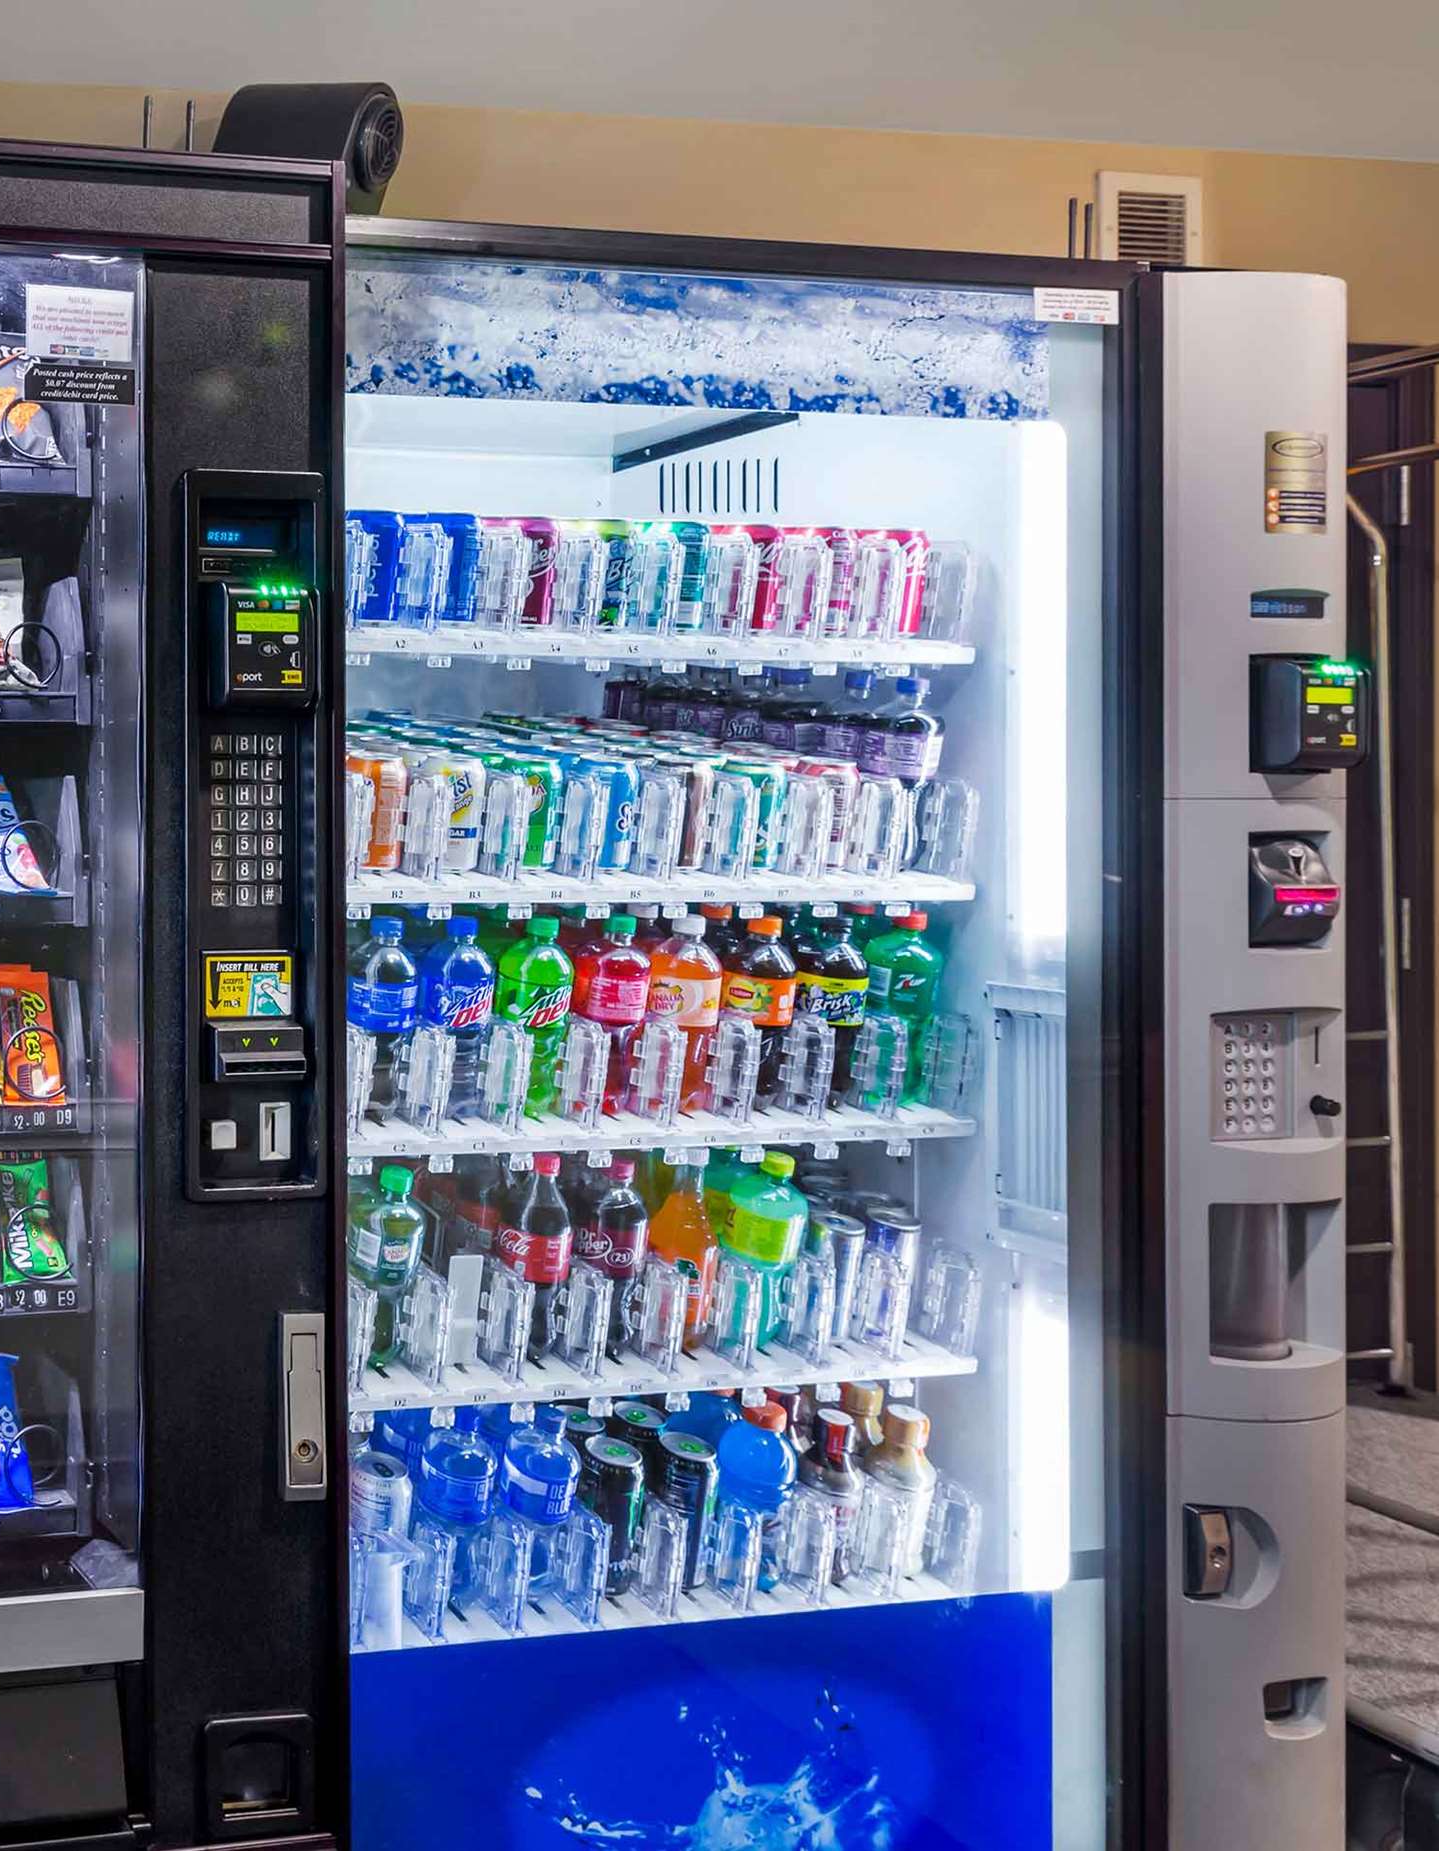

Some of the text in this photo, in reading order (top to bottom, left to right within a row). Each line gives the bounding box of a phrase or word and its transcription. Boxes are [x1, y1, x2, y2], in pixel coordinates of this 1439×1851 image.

[33, 368, 57, 377] Posted
[58, 369, 74, 378] cash
[75, 371, 94, 380] price
[95, 370, 121, 381] reflects
[66, 380, 115, 391] discount from
[82, 391, 98, 400] card
[237, 600, 255, 609] VISA
[214, 737, 274, 750] A B C
[214, 762, 274, 776] D E F
[214, 787, 274, 800] G H J
[216, 812, 274, 826] 1 2 3
[214, 838, 274, 850] 4 5 6
[214, 862, 274, 876] 7 8 9
[241, 887, 249, 901] 0
[217, 961, 279, 972] INSERT BILL HERE
[810, 993, 853, 1013] Brisk
[56, 1109, 72, 1125] D9
[580, 1227, 596, 1241] Dr
[500, 1228, 534, 1256] Cola
[58, 1290, 75, 1306] E9
